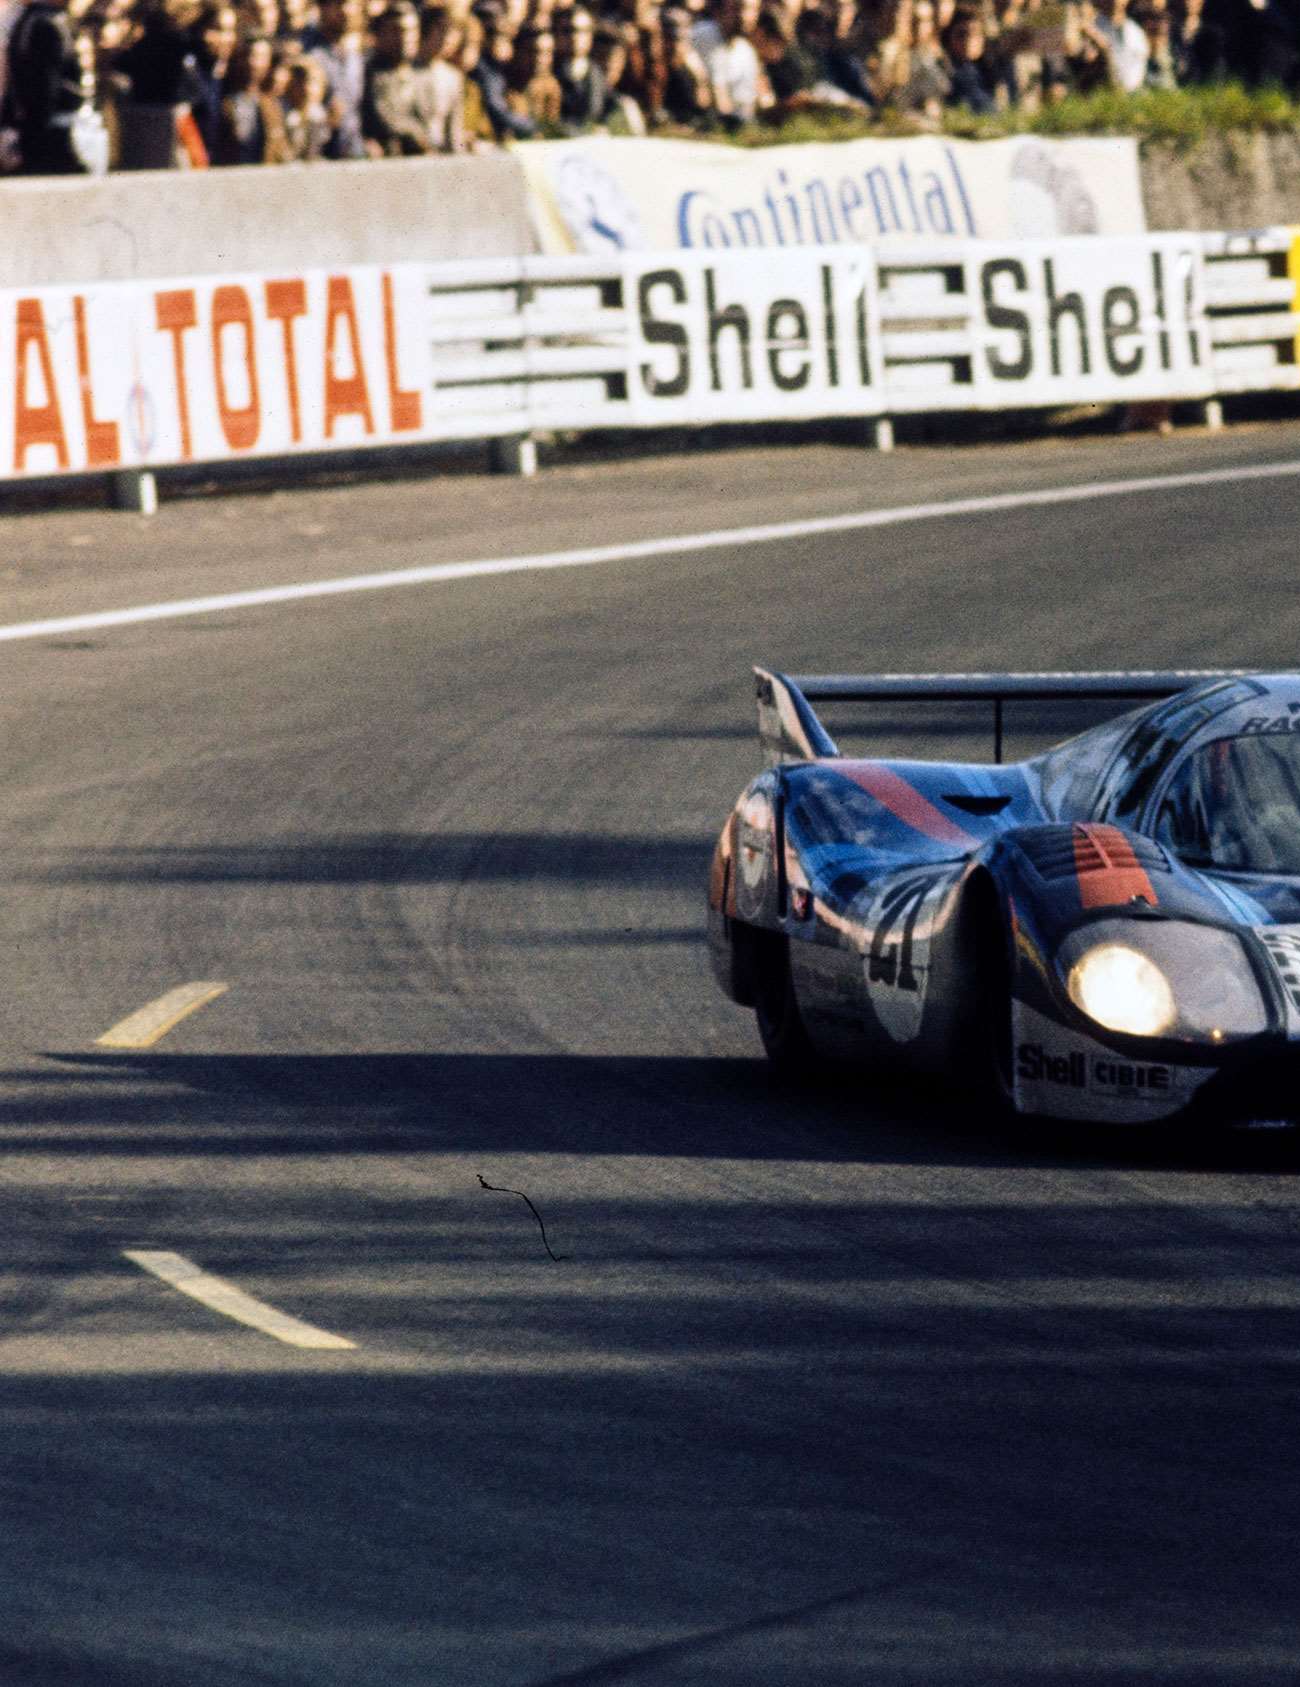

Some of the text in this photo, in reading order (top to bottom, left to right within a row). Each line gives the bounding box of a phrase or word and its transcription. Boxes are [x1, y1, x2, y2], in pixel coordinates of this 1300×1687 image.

[677, 146, 977, 251] Continental
[154, 271, 423, 464] TOTAL
[637, 263, 873, 397] Shell
[980, 249, 1201, 381] Shell
[1018, 1043, 1086, 1088] Shell
